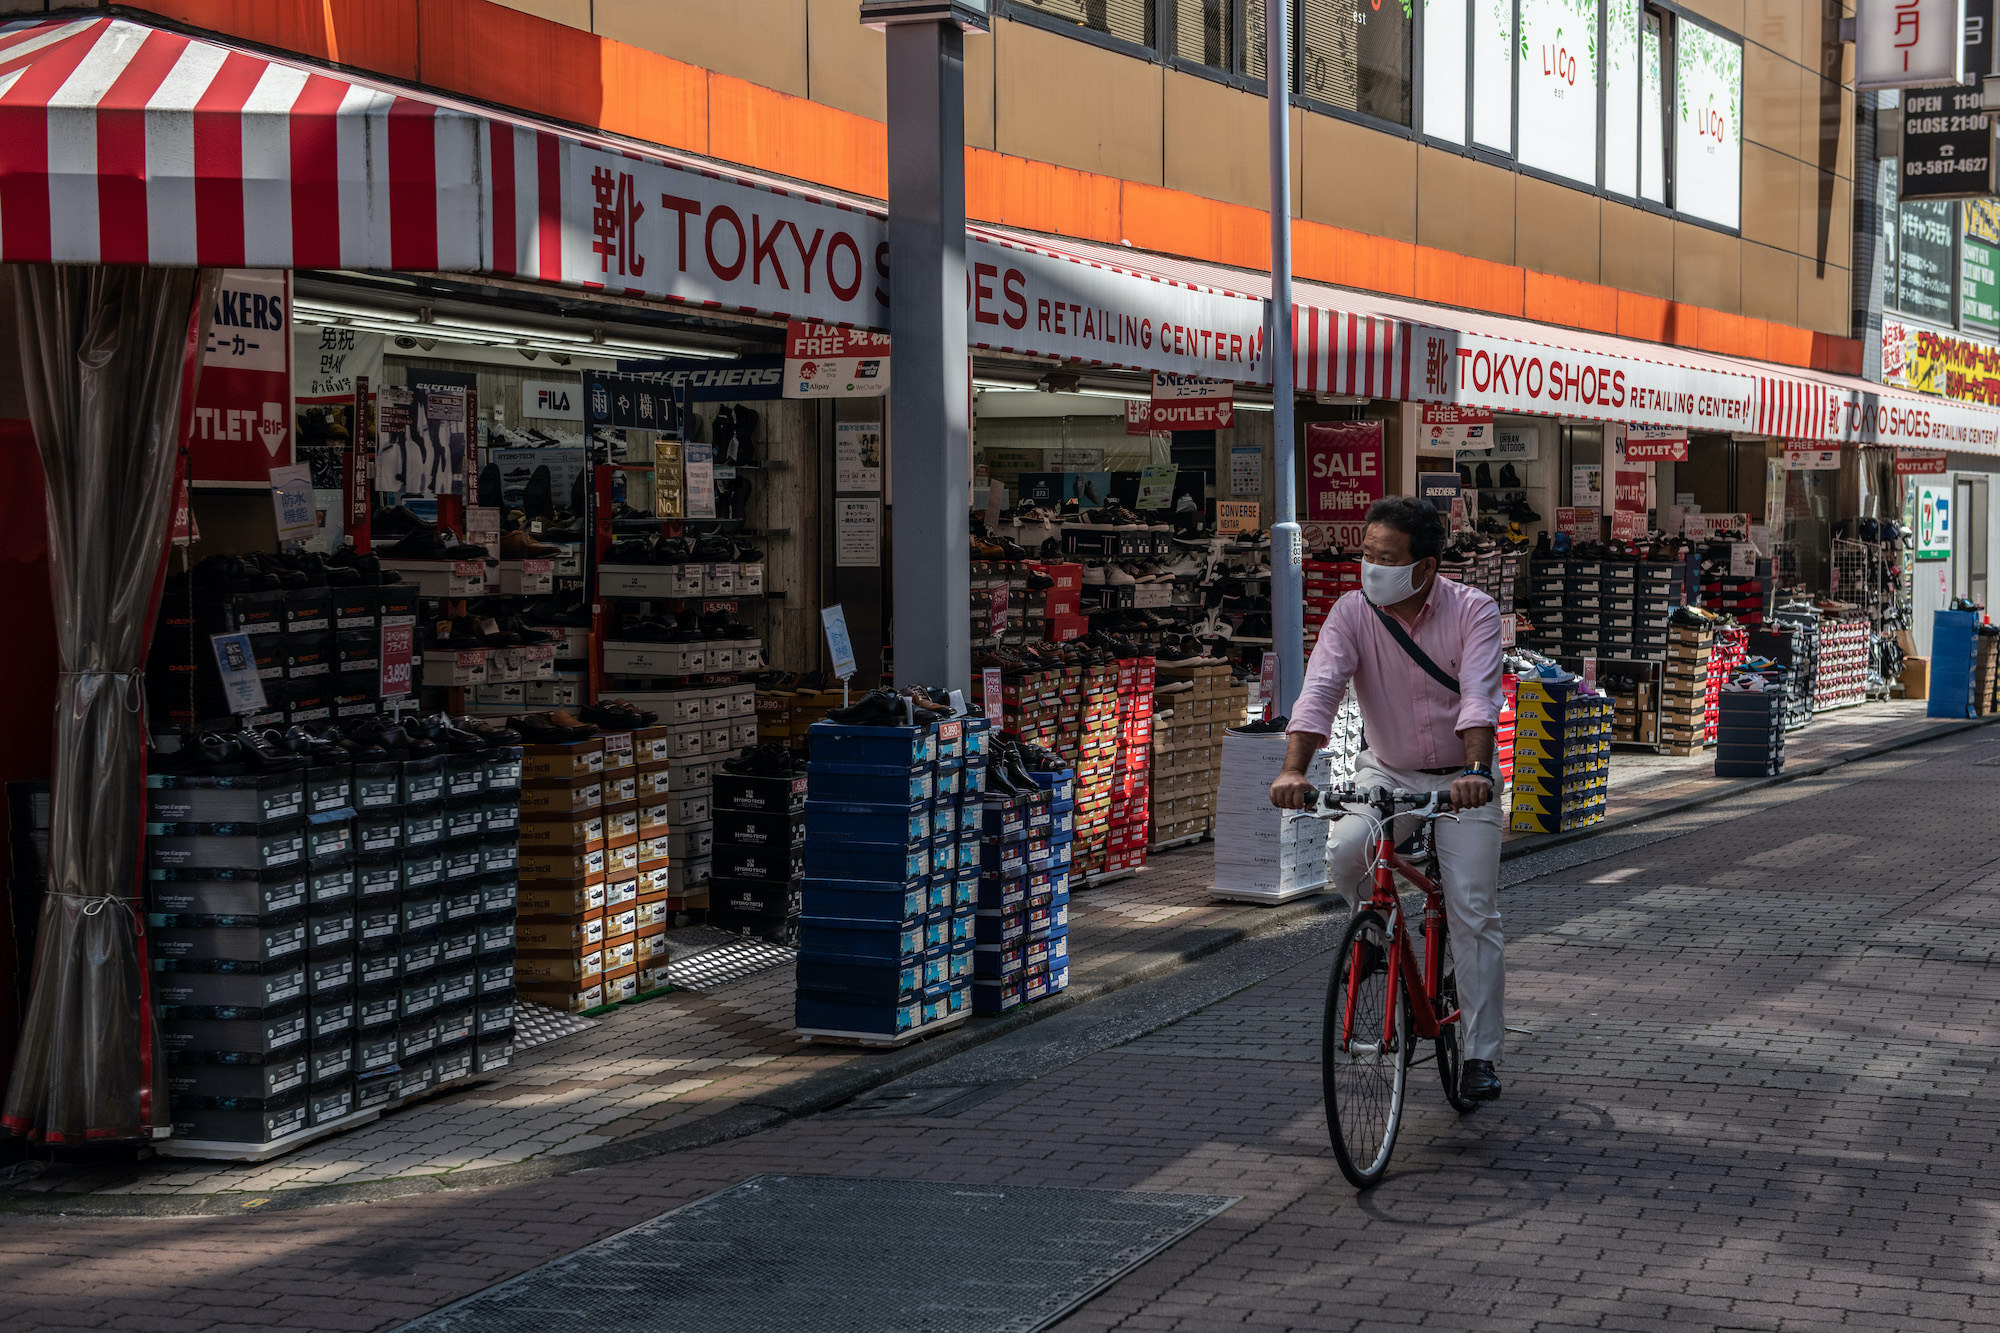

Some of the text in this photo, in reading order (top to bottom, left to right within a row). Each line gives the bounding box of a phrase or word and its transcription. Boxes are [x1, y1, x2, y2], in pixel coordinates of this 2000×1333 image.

[1542, 44, 1576, 86] LICO
[1907, 93, 1983, 113] OPEN 11:0
[1698, 107, 1724, 143] LICO
[1907, 115, 1988, 134] CLOSE 21:00
[1906, 158, 1988, 176] 03-5817-4627
[591, 166, 645, 277] 靴
[661, 197, 862, 302] TOKYO
[875, 237, 1027, 331] SES
[1039, 301, 1152, 350] RETAILING
[800, 321, 840, 338] TAX
[318, 327, 355, 351] 免税
[794, 336, 845, 356] FREE
[1426, 337, 1448, 394] 靴
[809, 382, 829, 391] Alipay
[1456, 347, 1543, 398] TOKYO
[1549, 361, 1626, 408] SHOES
[1631, 387, 1694, 415] RETAILING
[538, 390, 570, 411] FILA
[1177, 388, 1216, 396] スニーカー
[1154, 406, 1216, 422] OUTLET
[1427, 411, 1459, 422] FREE
[1843, 401, 1888, 435] TOKYO
[1890, 407, 1930, 438] SHOES
[1932, 422, 1968, 441] RETAILING
[1500, 435, 1520, 443] URBAN
[1788, 440, 1814, 450] FREE
[1628, 444, 1672, 456] OUTLET
[1313, 452, 1376, 478] SALE
[1897, 462, 1934, 471] OUTLET
[1330, 478, 1359, 489] セール
[1425, 487, 1457, 497] SKECHERS
[1615, 484, 1640, 500] OUTLET
[281, 490, 306, 509] 防水
[1035, 489, 1047, 497] 373
[1319, 490, 1371, 511] 開催中
[283, 507, 309, 524] 機能
[1220, 504, 1257, 518] CONVERSE
[1326, 525, 1362, 548] 3,90
